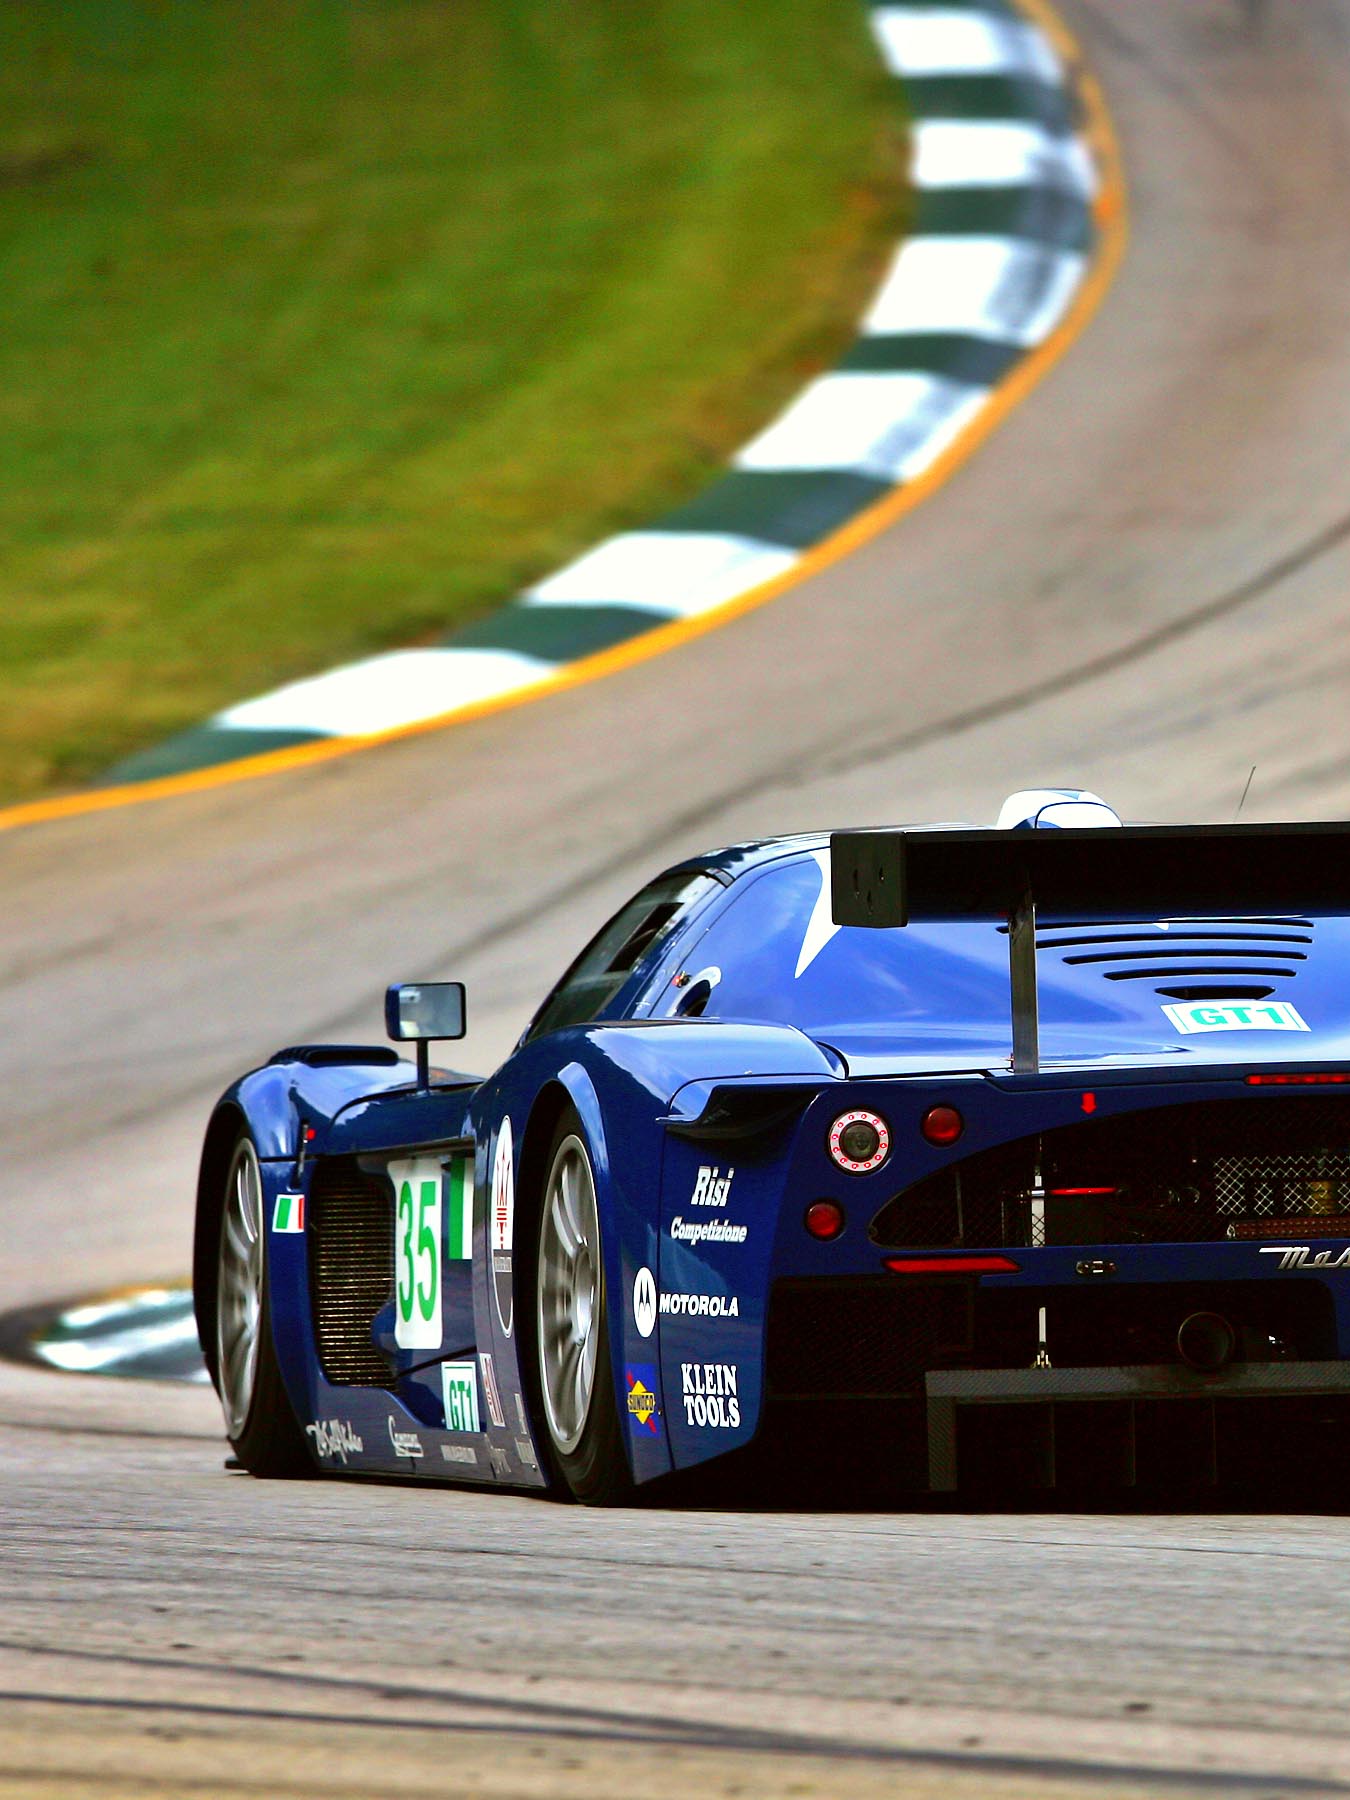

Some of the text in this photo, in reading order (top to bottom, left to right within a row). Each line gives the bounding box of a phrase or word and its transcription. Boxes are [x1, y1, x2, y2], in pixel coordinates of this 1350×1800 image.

[1189, 1007, 1286, 1026] GT1
[690, 1165, 734, 1207] Risi
[670, 1216, 748, 1246] Competizione
[399, 1181, 437, 1322] 35
[659, 1293, 739, 1317] MOTOROLA
[681, 1363, 737, 1396] KLEIN
[449, 1380, 475, 1432] GT1
[683, 1394, 741, 1428] TOOLS
